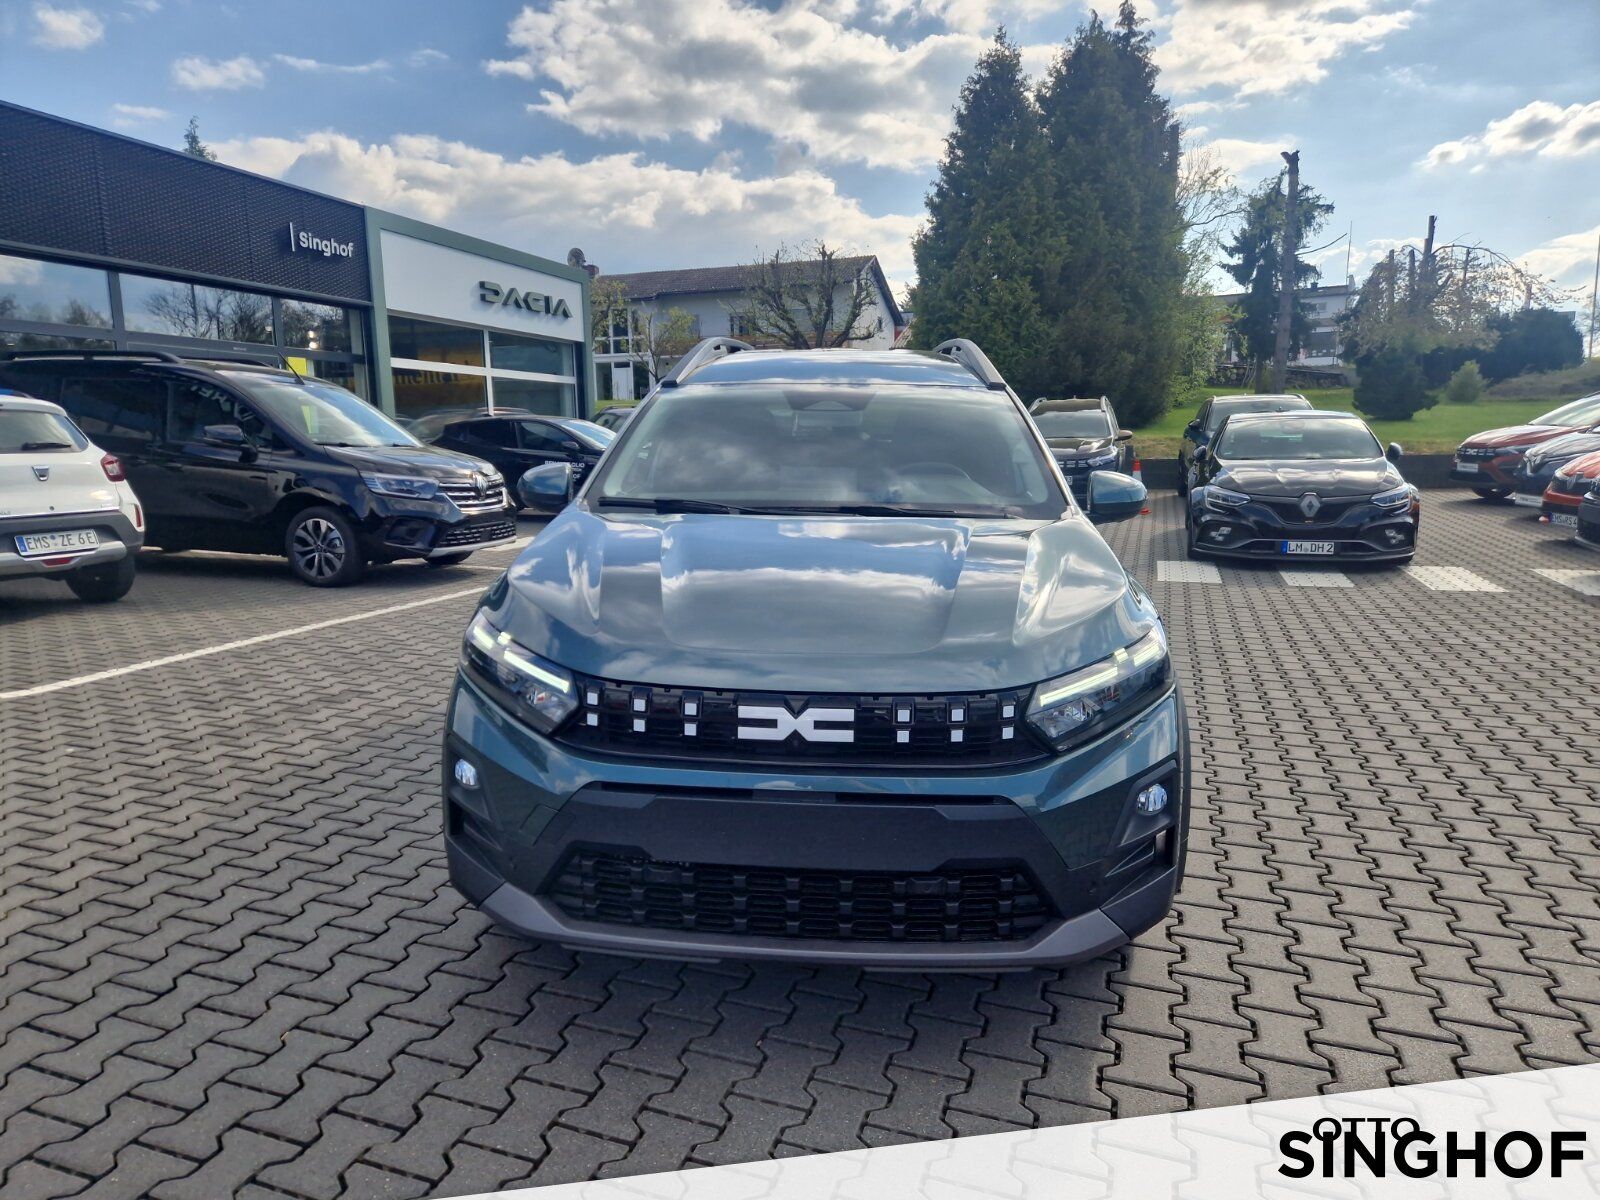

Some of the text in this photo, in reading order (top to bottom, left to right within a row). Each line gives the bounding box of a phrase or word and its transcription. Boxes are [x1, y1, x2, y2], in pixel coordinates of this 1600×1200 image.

[299, 231, 354, 257] Singhof
[479, 281, 573, 318] DACIA
[26, 536, 51, 550] EMS
[60, 534, 75, 547] ZE
[1288, 542, 1333, 553] LM DH 2
